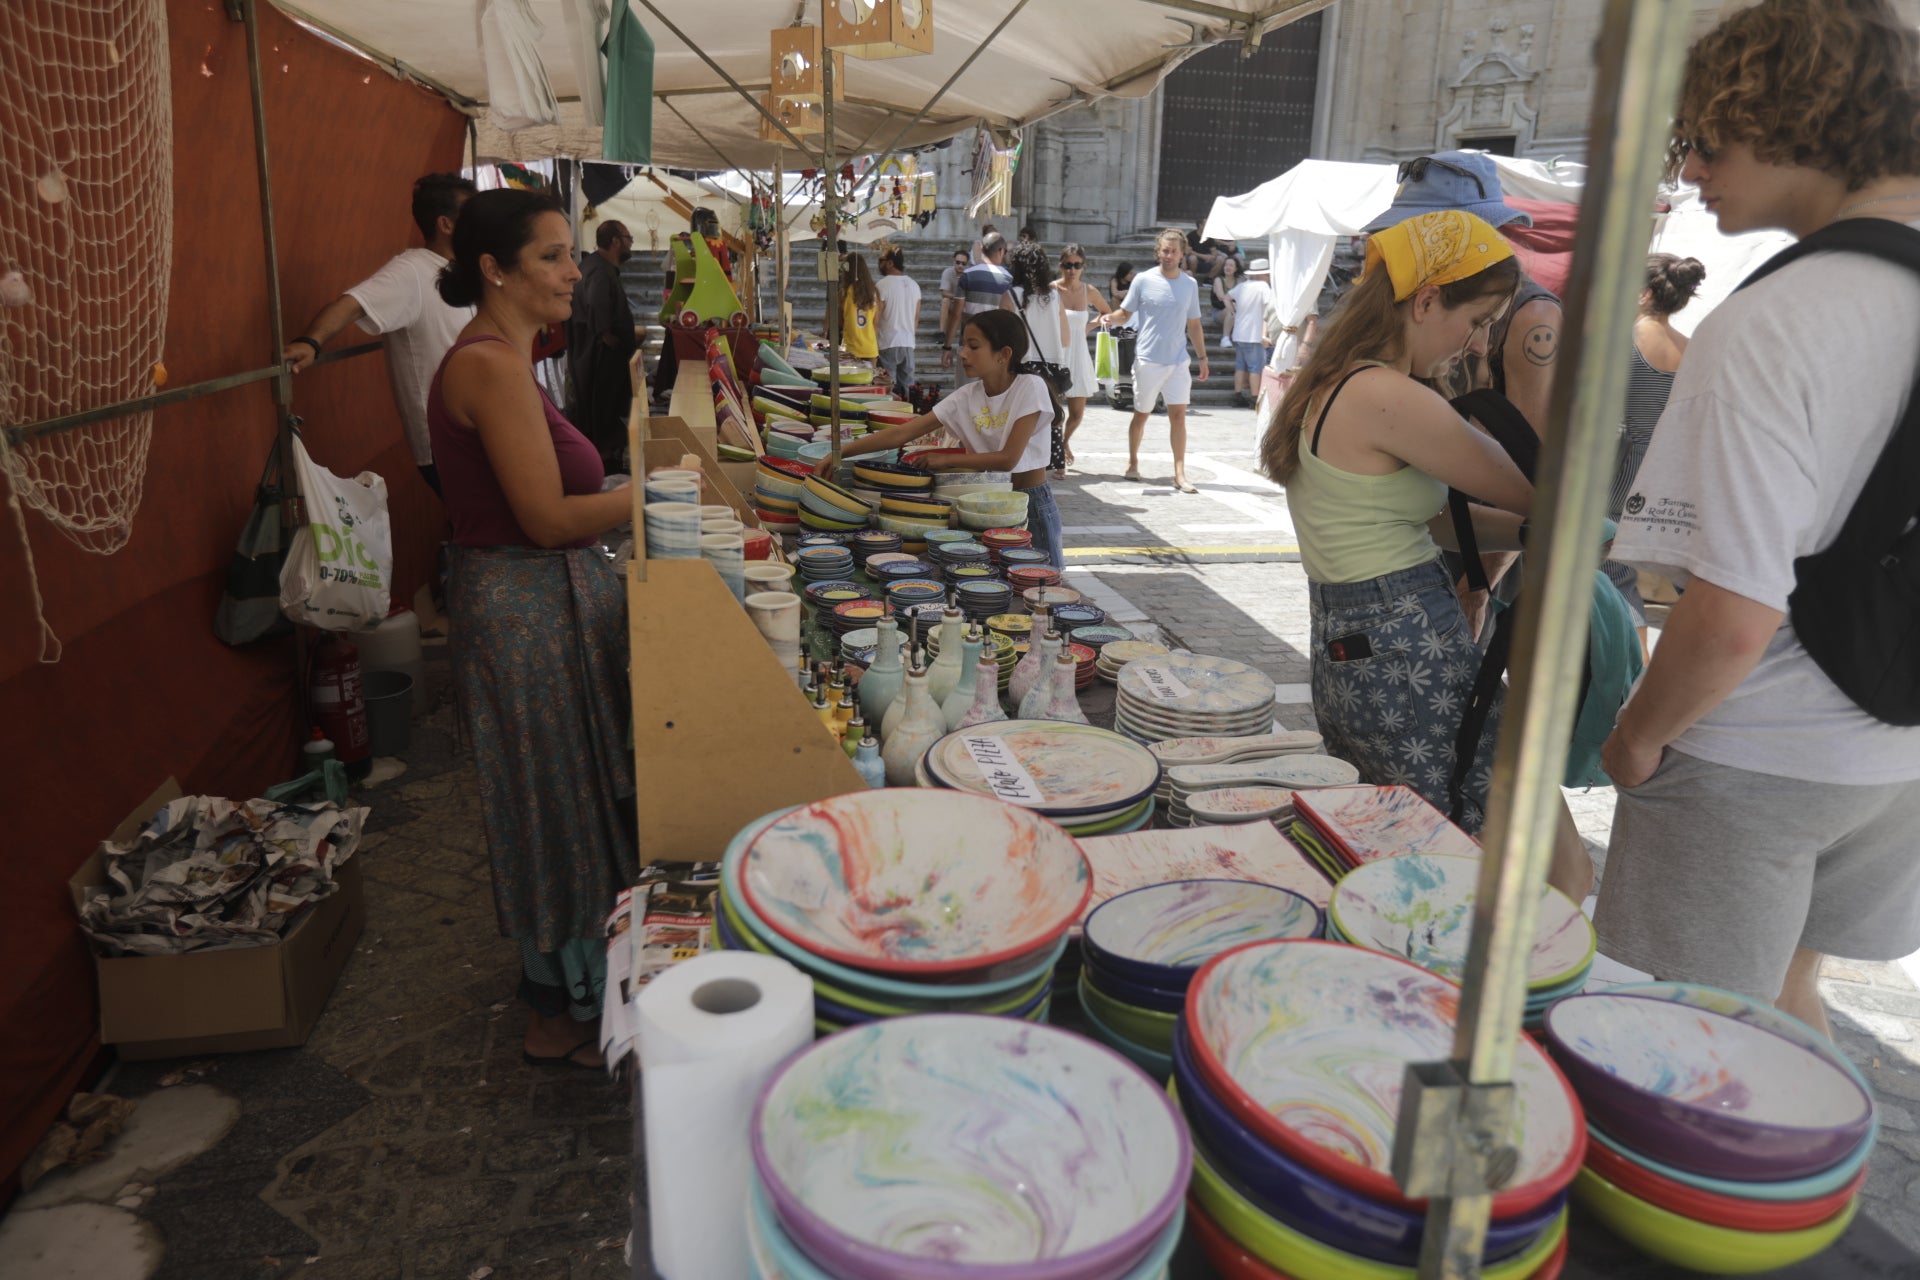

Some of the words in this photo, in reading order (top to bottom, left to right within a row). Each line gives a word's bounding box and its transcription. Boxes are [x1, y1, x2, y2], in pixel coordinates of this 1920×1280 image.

[856, 308, 867, 328] 6
[1648, 507, 1666, 517] Rod
[967, 738, 1007, 765] PIZZA
